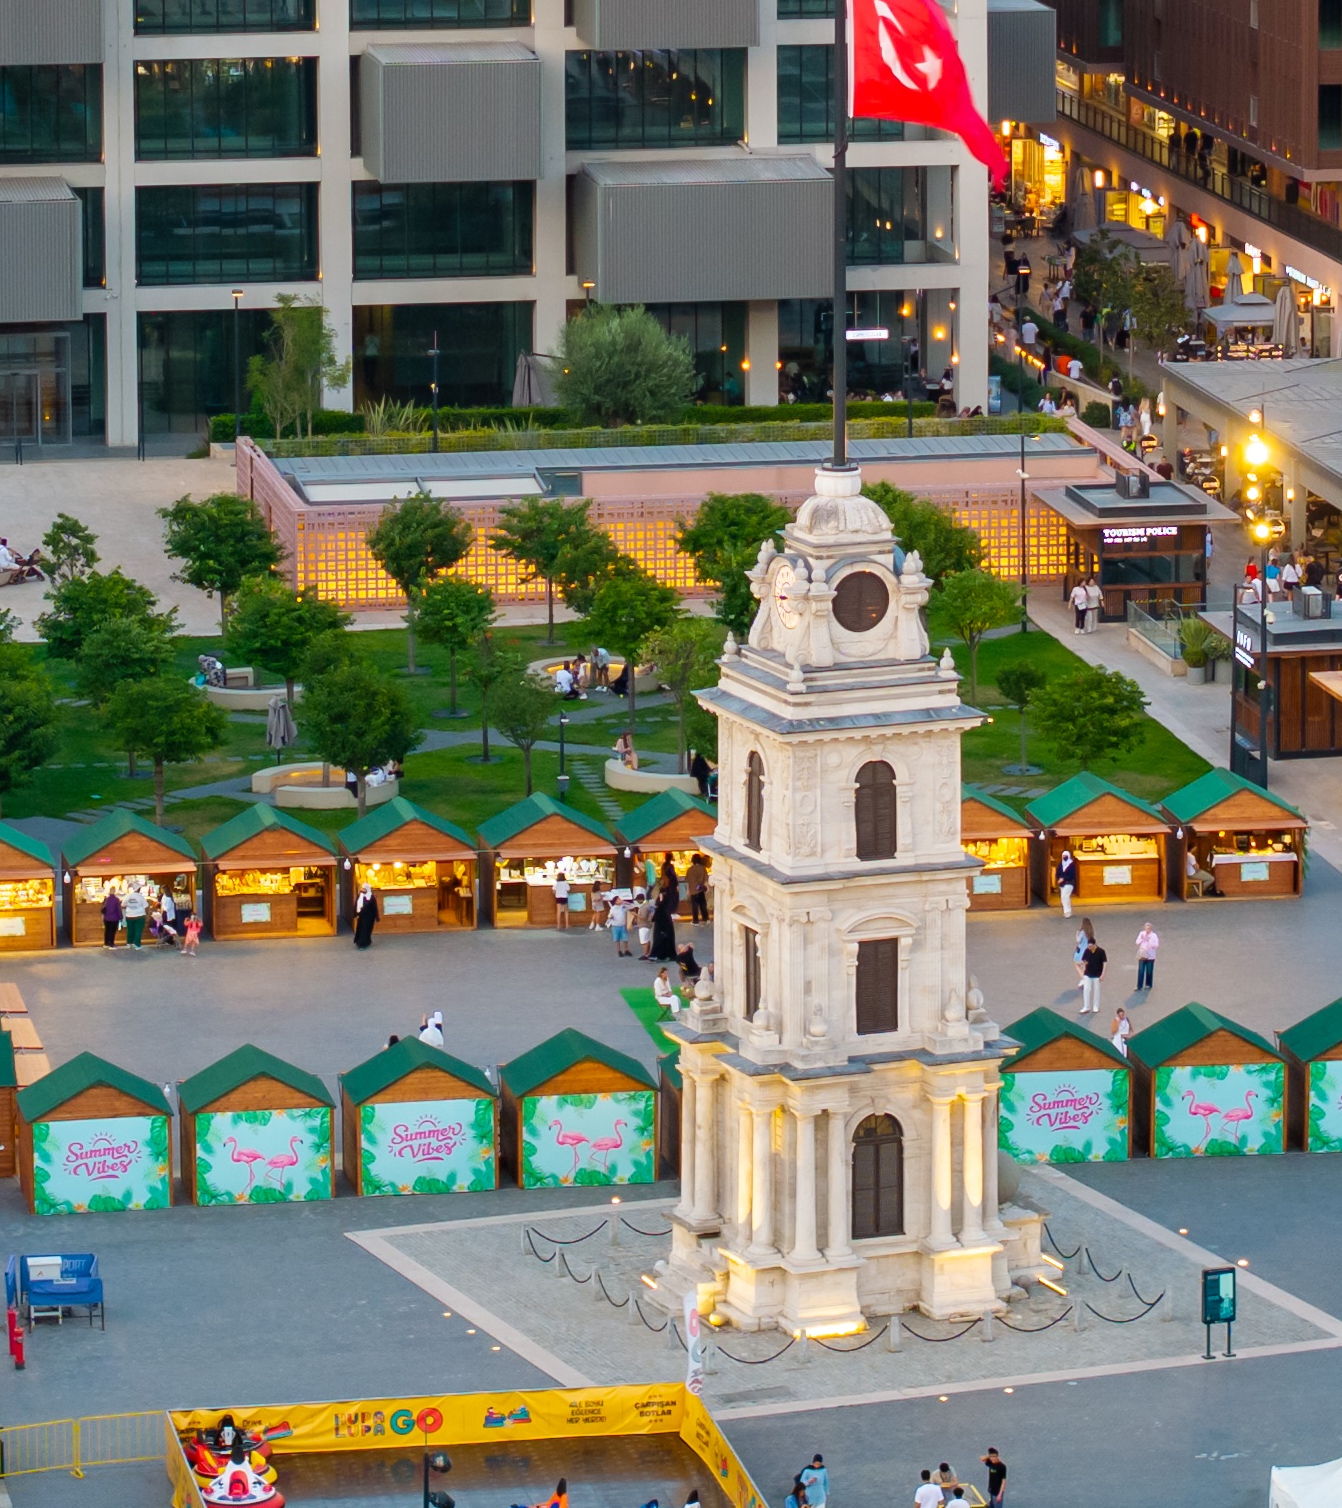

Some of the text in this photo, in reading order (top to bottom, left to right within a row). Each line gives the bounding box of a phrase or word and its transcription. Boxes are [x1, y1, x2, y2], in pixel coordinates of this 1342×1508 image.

[1103, 526, 1178, 538] TOURISM POLICE
[1029, 1092, 1099, 1113] Summer
[1035, 1110, 1094, 1127] Vibes
[391, 1122, 462, 1145] Summer
[65, 1140, 138, 1163] Summer
[398, 1141, 457, 1159] Vibes
[72, 1159, 133, 1177] Vibes
[390, 1407, 444, 1435] GO
[639, 1409, 672, 1418] BOTLAR
[334, 1424, 385, 1438] LUPA
